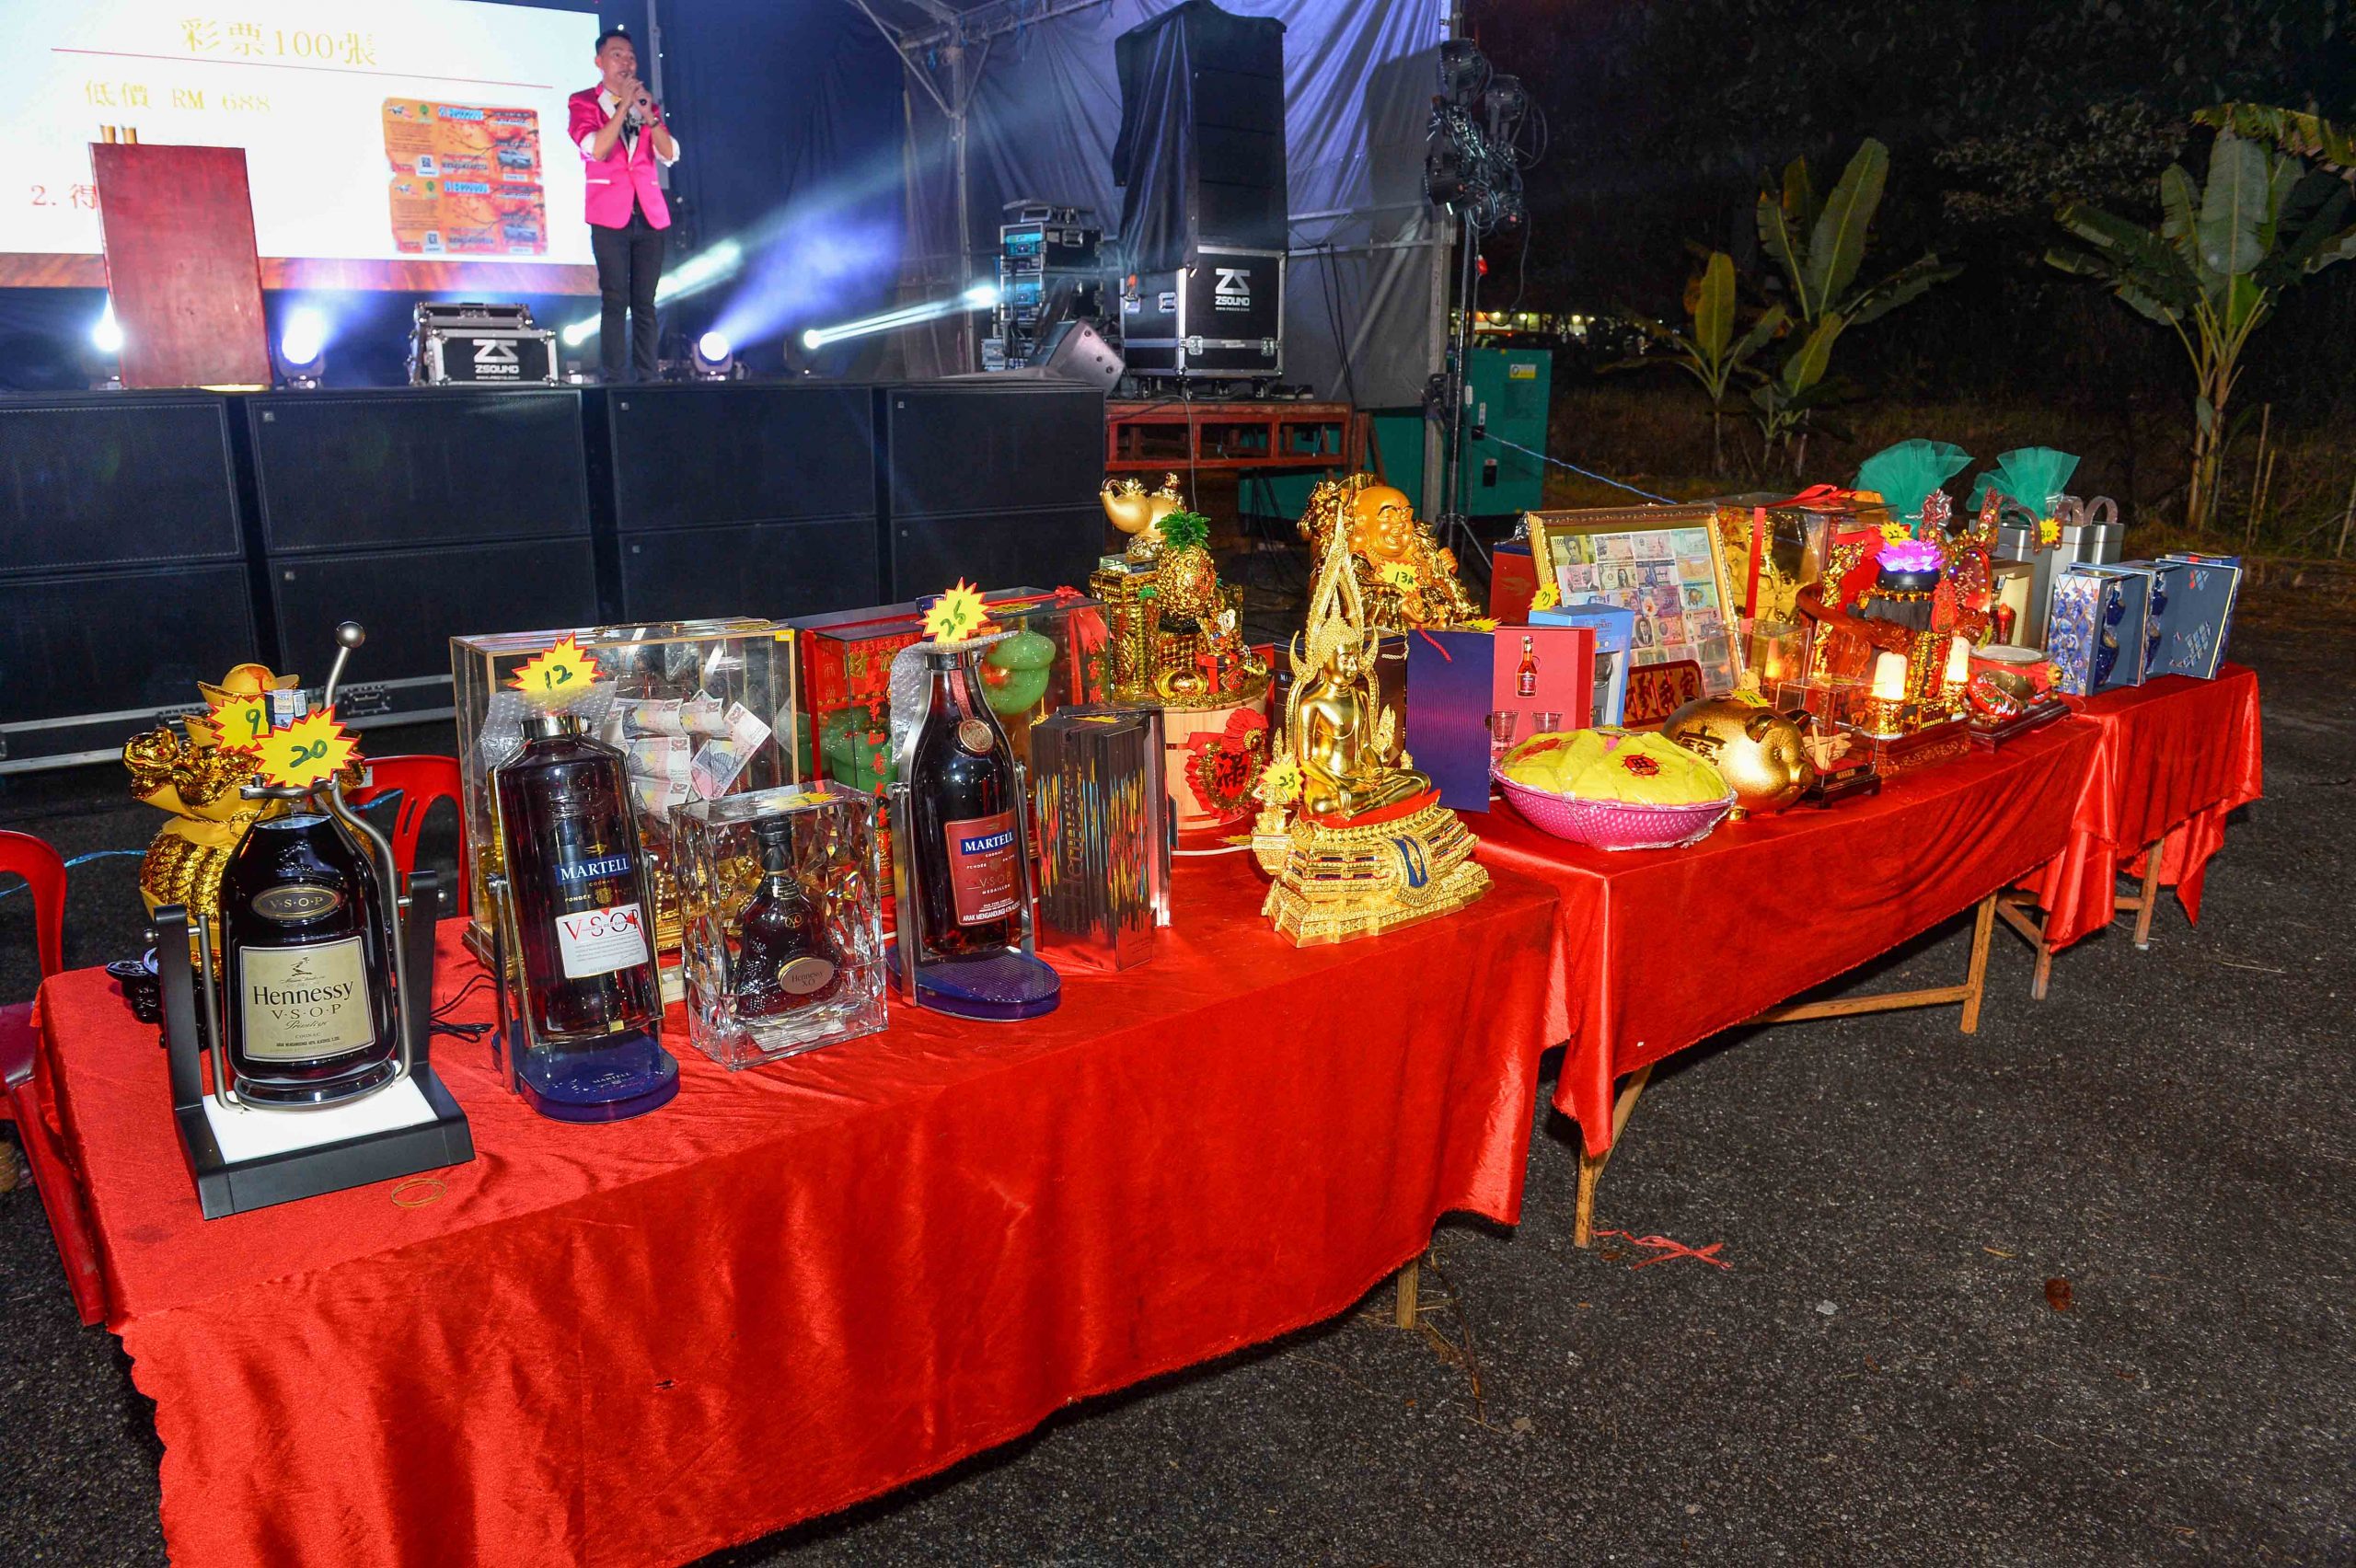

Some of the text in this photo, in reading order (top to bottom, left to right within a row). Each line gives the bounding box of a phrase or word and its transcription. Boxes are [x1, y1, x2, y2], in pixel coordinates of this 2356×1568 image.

[171, 87, 205, 110] RM
[221, 93, 271, 112] 688
[1215, 295, 1250, 306] ZSOUND
[475, 364, 520, 375] ZSOUND
[544, 663, 574, 691] 12
[245, 707, 261, 736] 9
[289, 738, 329, 769] 20
[964, 831, 1014, 852] MARTELL
[560, 858, 629, 881] MARTELL
[791, 971, 824, 984] Hennessy
[252, 981, 353, 1006] Hennessy
